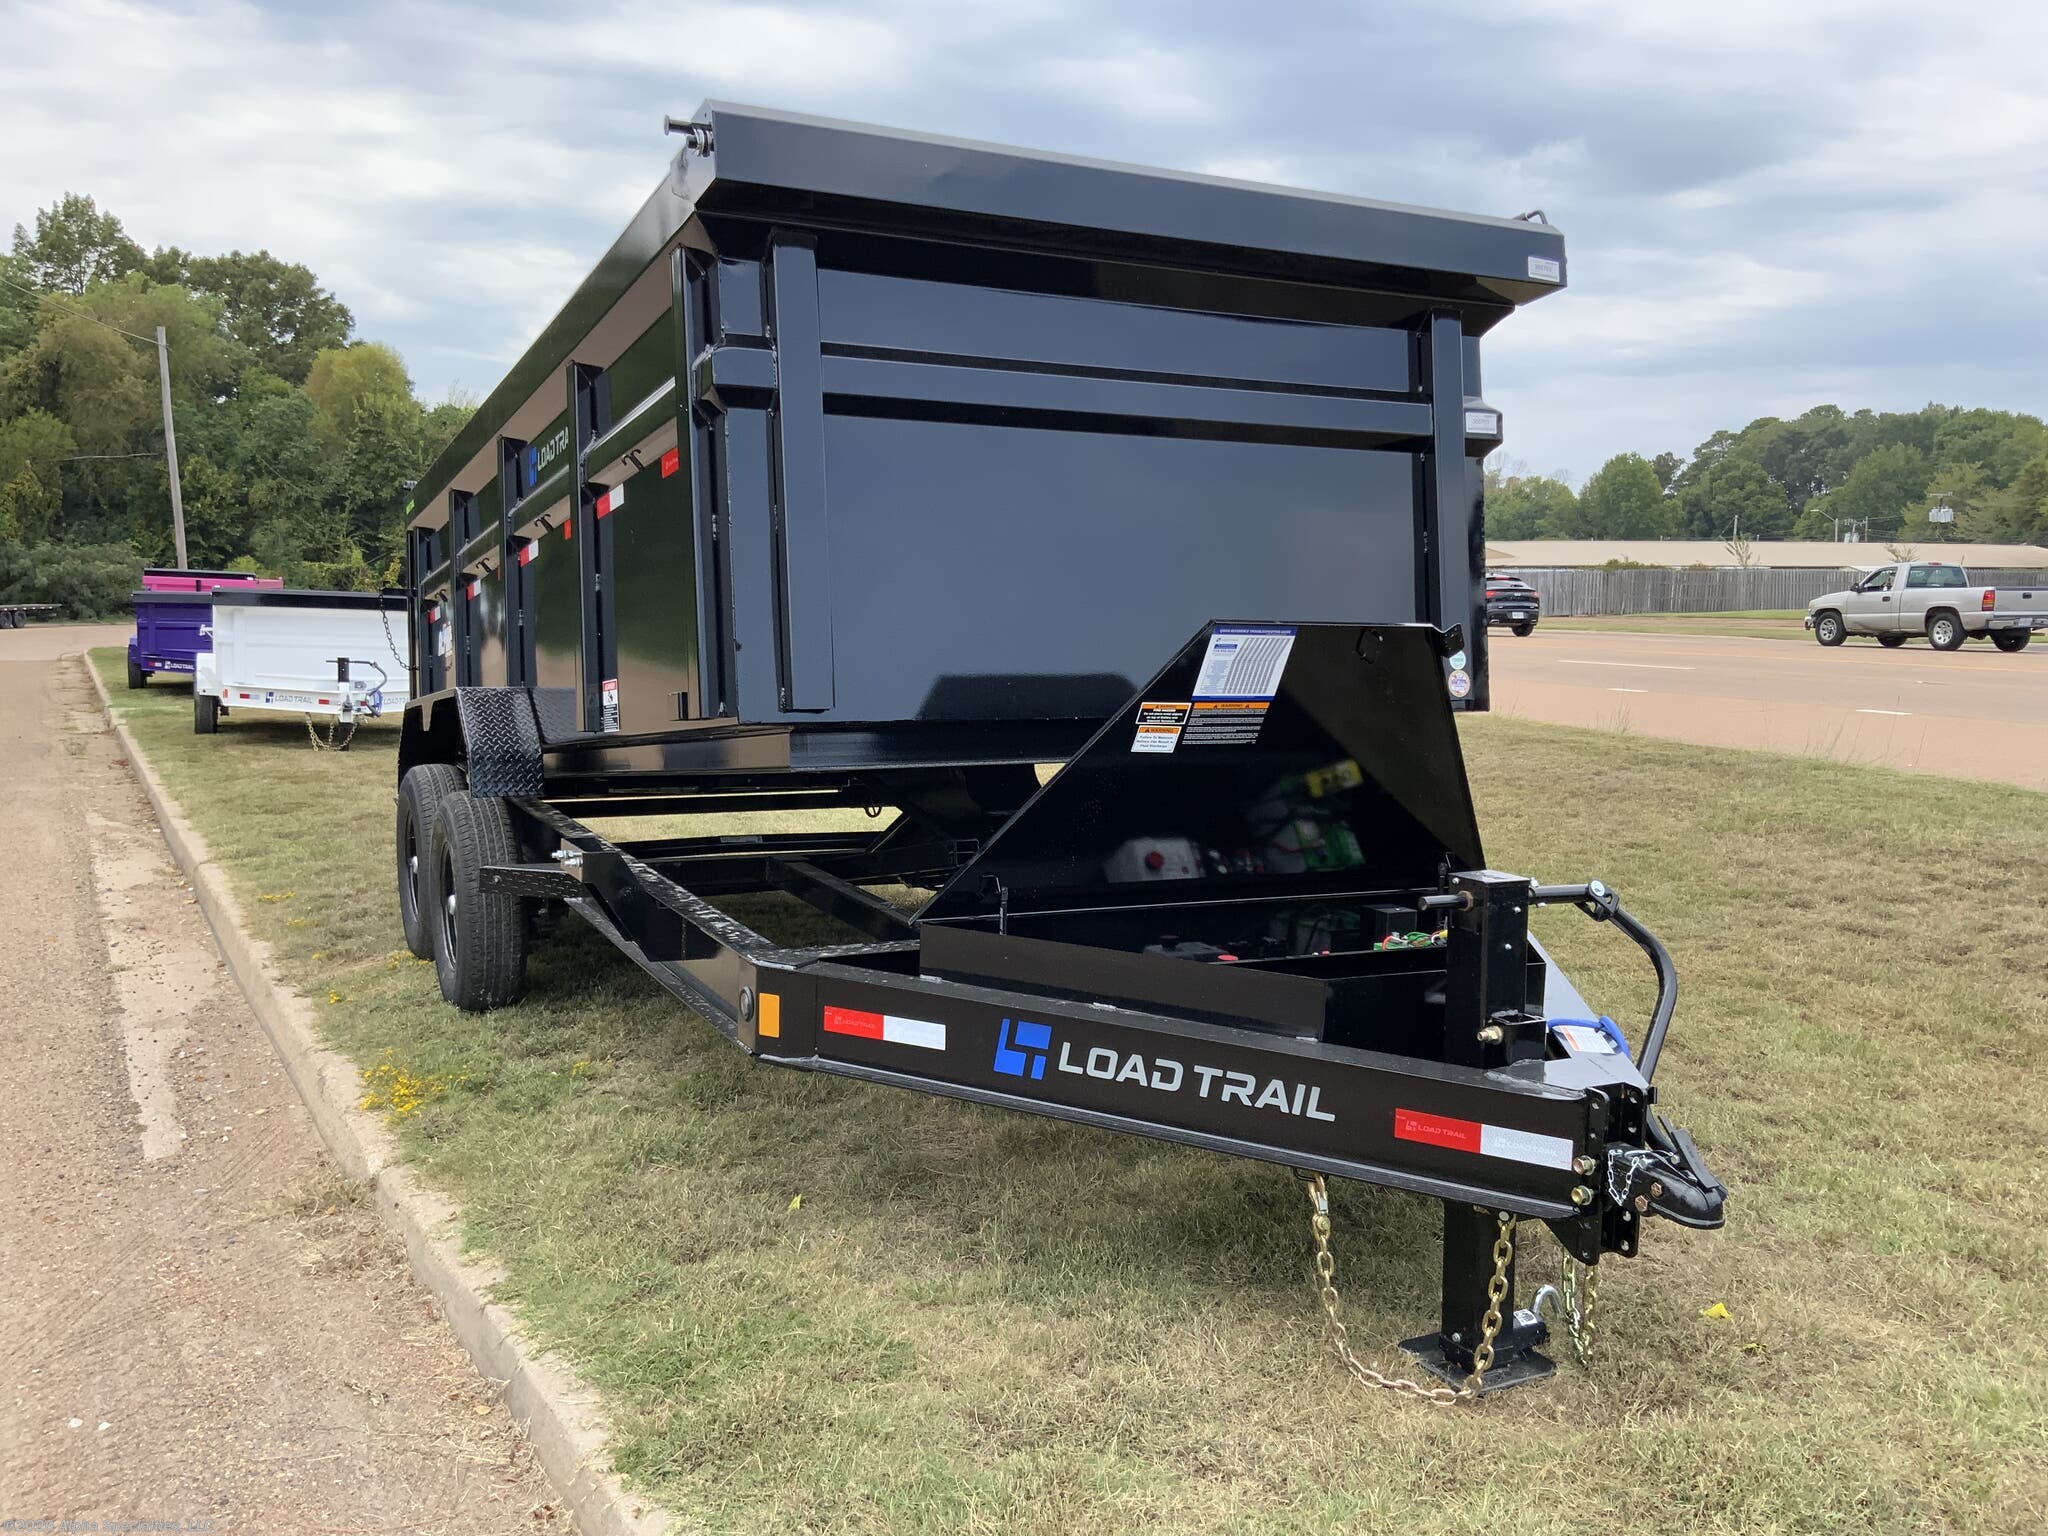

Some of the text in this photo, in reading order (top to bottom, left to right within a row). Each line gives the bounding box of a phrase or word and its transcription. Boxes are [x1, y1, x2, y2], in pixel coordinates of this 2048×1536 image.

[537, 426, 569, 471] LOAD TRA
[275, 694, 312, 704] LOAD TRAIL
[1059, 1041, 1336, 1122] LOAD TRAIL
[1417, 1124, 1467, 1139] LOAD TRAIL
